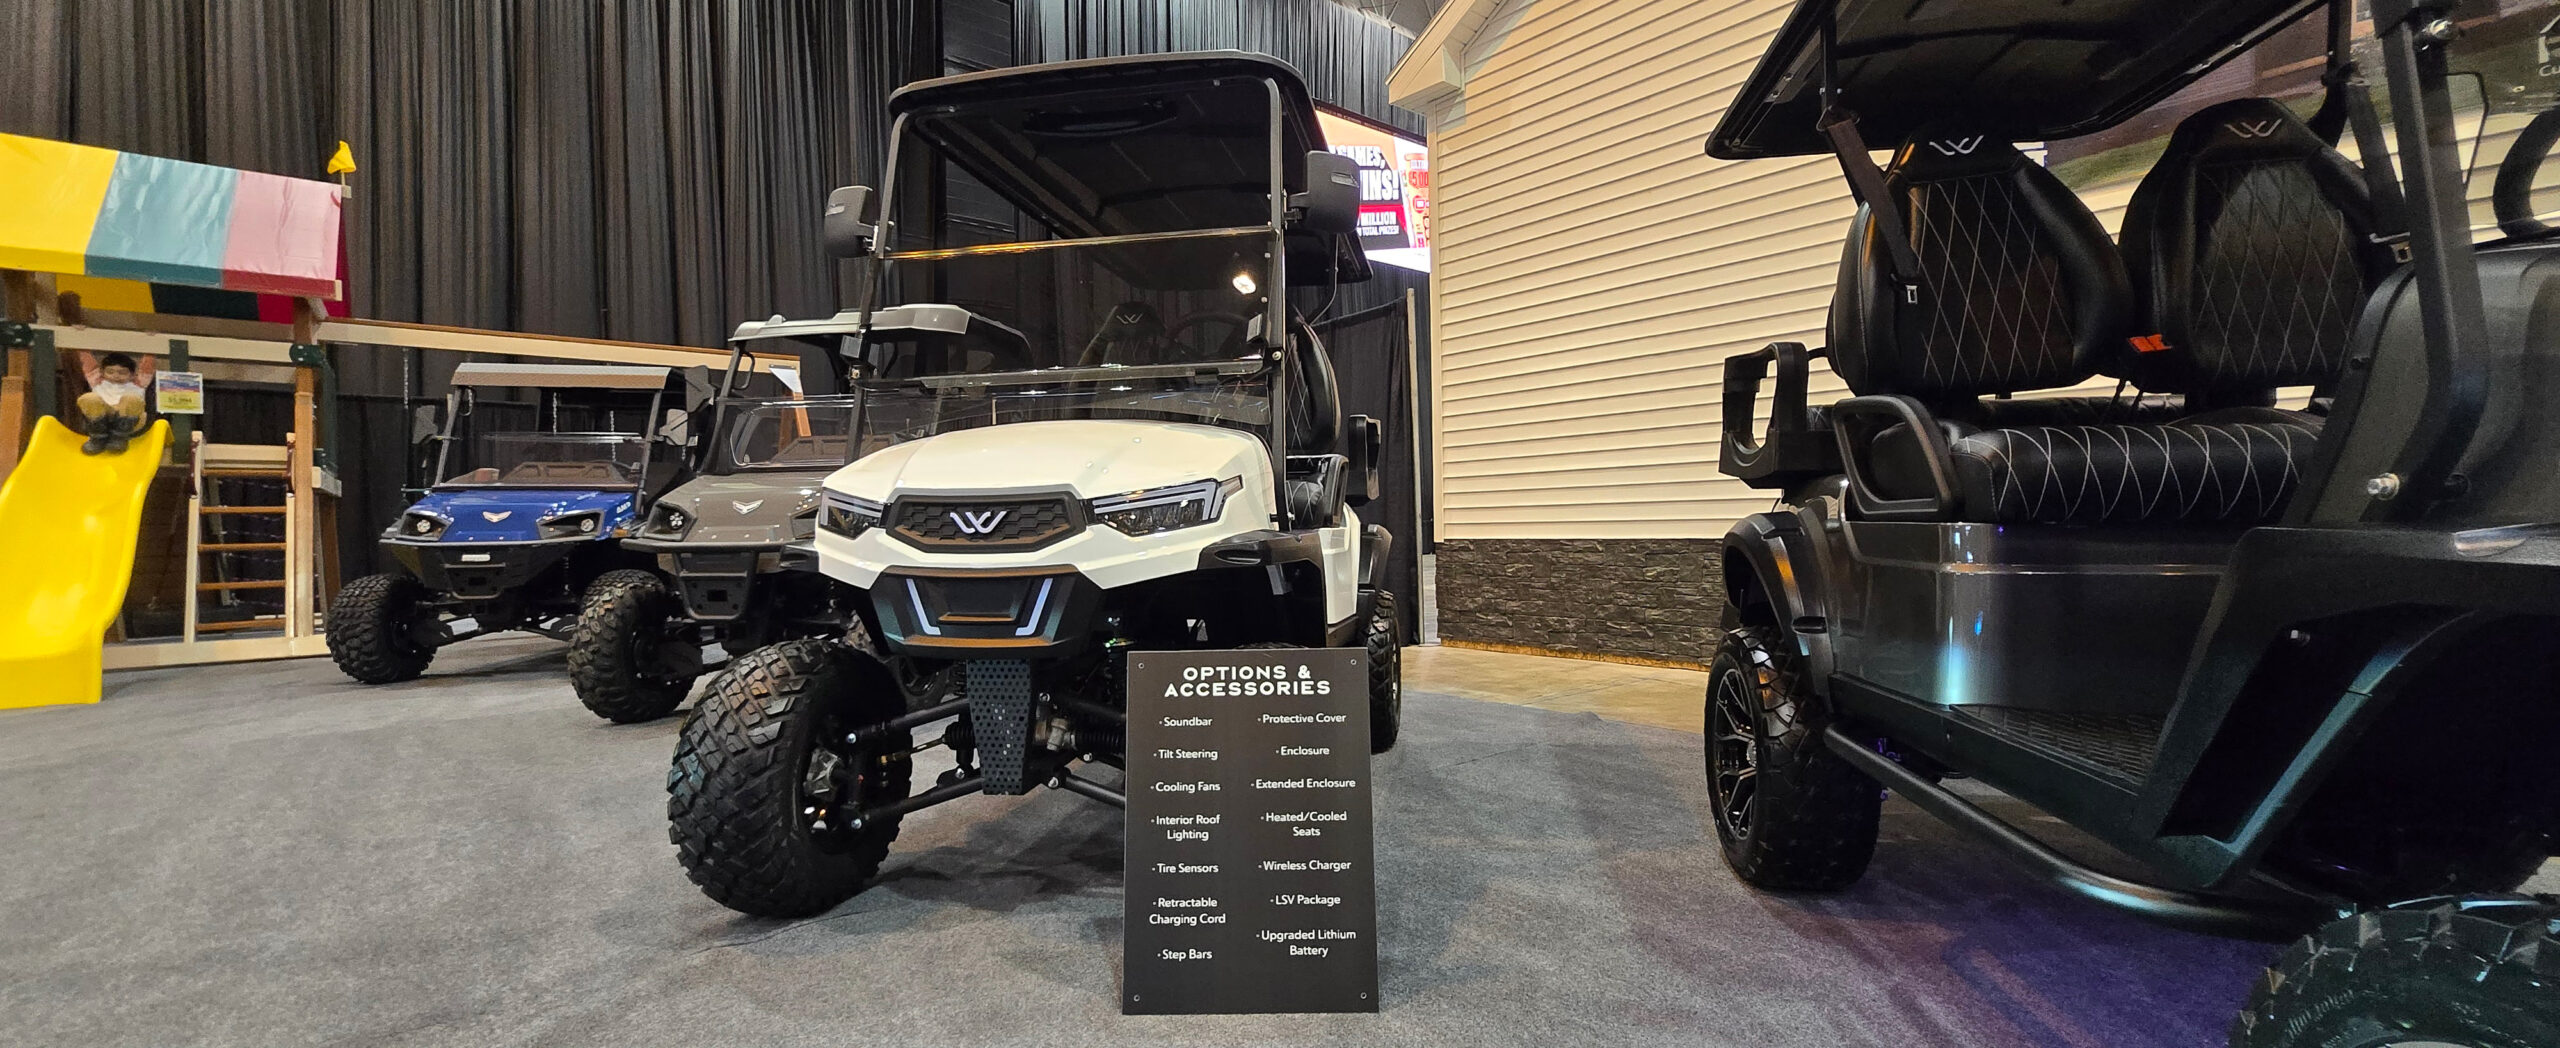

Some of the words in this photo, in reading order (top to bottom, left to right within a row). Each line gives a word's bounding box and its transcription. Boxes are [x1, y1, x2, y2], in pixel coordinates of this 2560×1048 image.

[1360, 170, 1399, 201] INS!
[1361, 211, 1396, 226] MILLION
[1183, 665, 1287, 681] OPTIONS
[1298, 665, 1311, 679] &
[1164, 680, 1330, 697] ACCESSORIES
[1164, 717, 1212, 726] Soundbar
[1263, 714, 1313, 723] Protective
[1316, 713, 1346, 722] Cover
[1158, 749, 1173, 759] Tilt
[1176, 749, 1218, 760] Steering
[1281, 746, 1330, 755] Enclosure
[1156, 782, 1195, 793] Cooling
[1198, 781, 1220, 791] Fans
[1256, 779, 1304, 789] Extended
[1307, 778, 1356, 788] Enclosure
[1157, 815, 1192, 825] Interior
[1197, 814, 1220, 824] Roof
[1266, 811, 1347, 822] Heated/Cooled
[1167, 829, 1209, 841] Lighting
[1293, 827, 1320, 836] Seats
[1157, 863, 1176, 873] Tire
[1178, 863, 1219, 873] Sensors
[1263, 861, 1307, 870] Wireless
[1309, 860, 1351, 872] Charger
[1158, 897, 1217, 907] Retractable
[1276, 895, 1295, 905] LSV
[1297, 895, 1340, 907] Package
[1149, 914, 1197, 926] Charging
[1199, 913, 1226, 923] Cord
[1262, 929, 1315, 942] Upgraded
[1318, 929, 1356, 939] Lithium
[1163, 949, 1186, 961] Step
[1189, 949, 1212, 959] Bars
[1290, 945, 1328, 957] Battery
